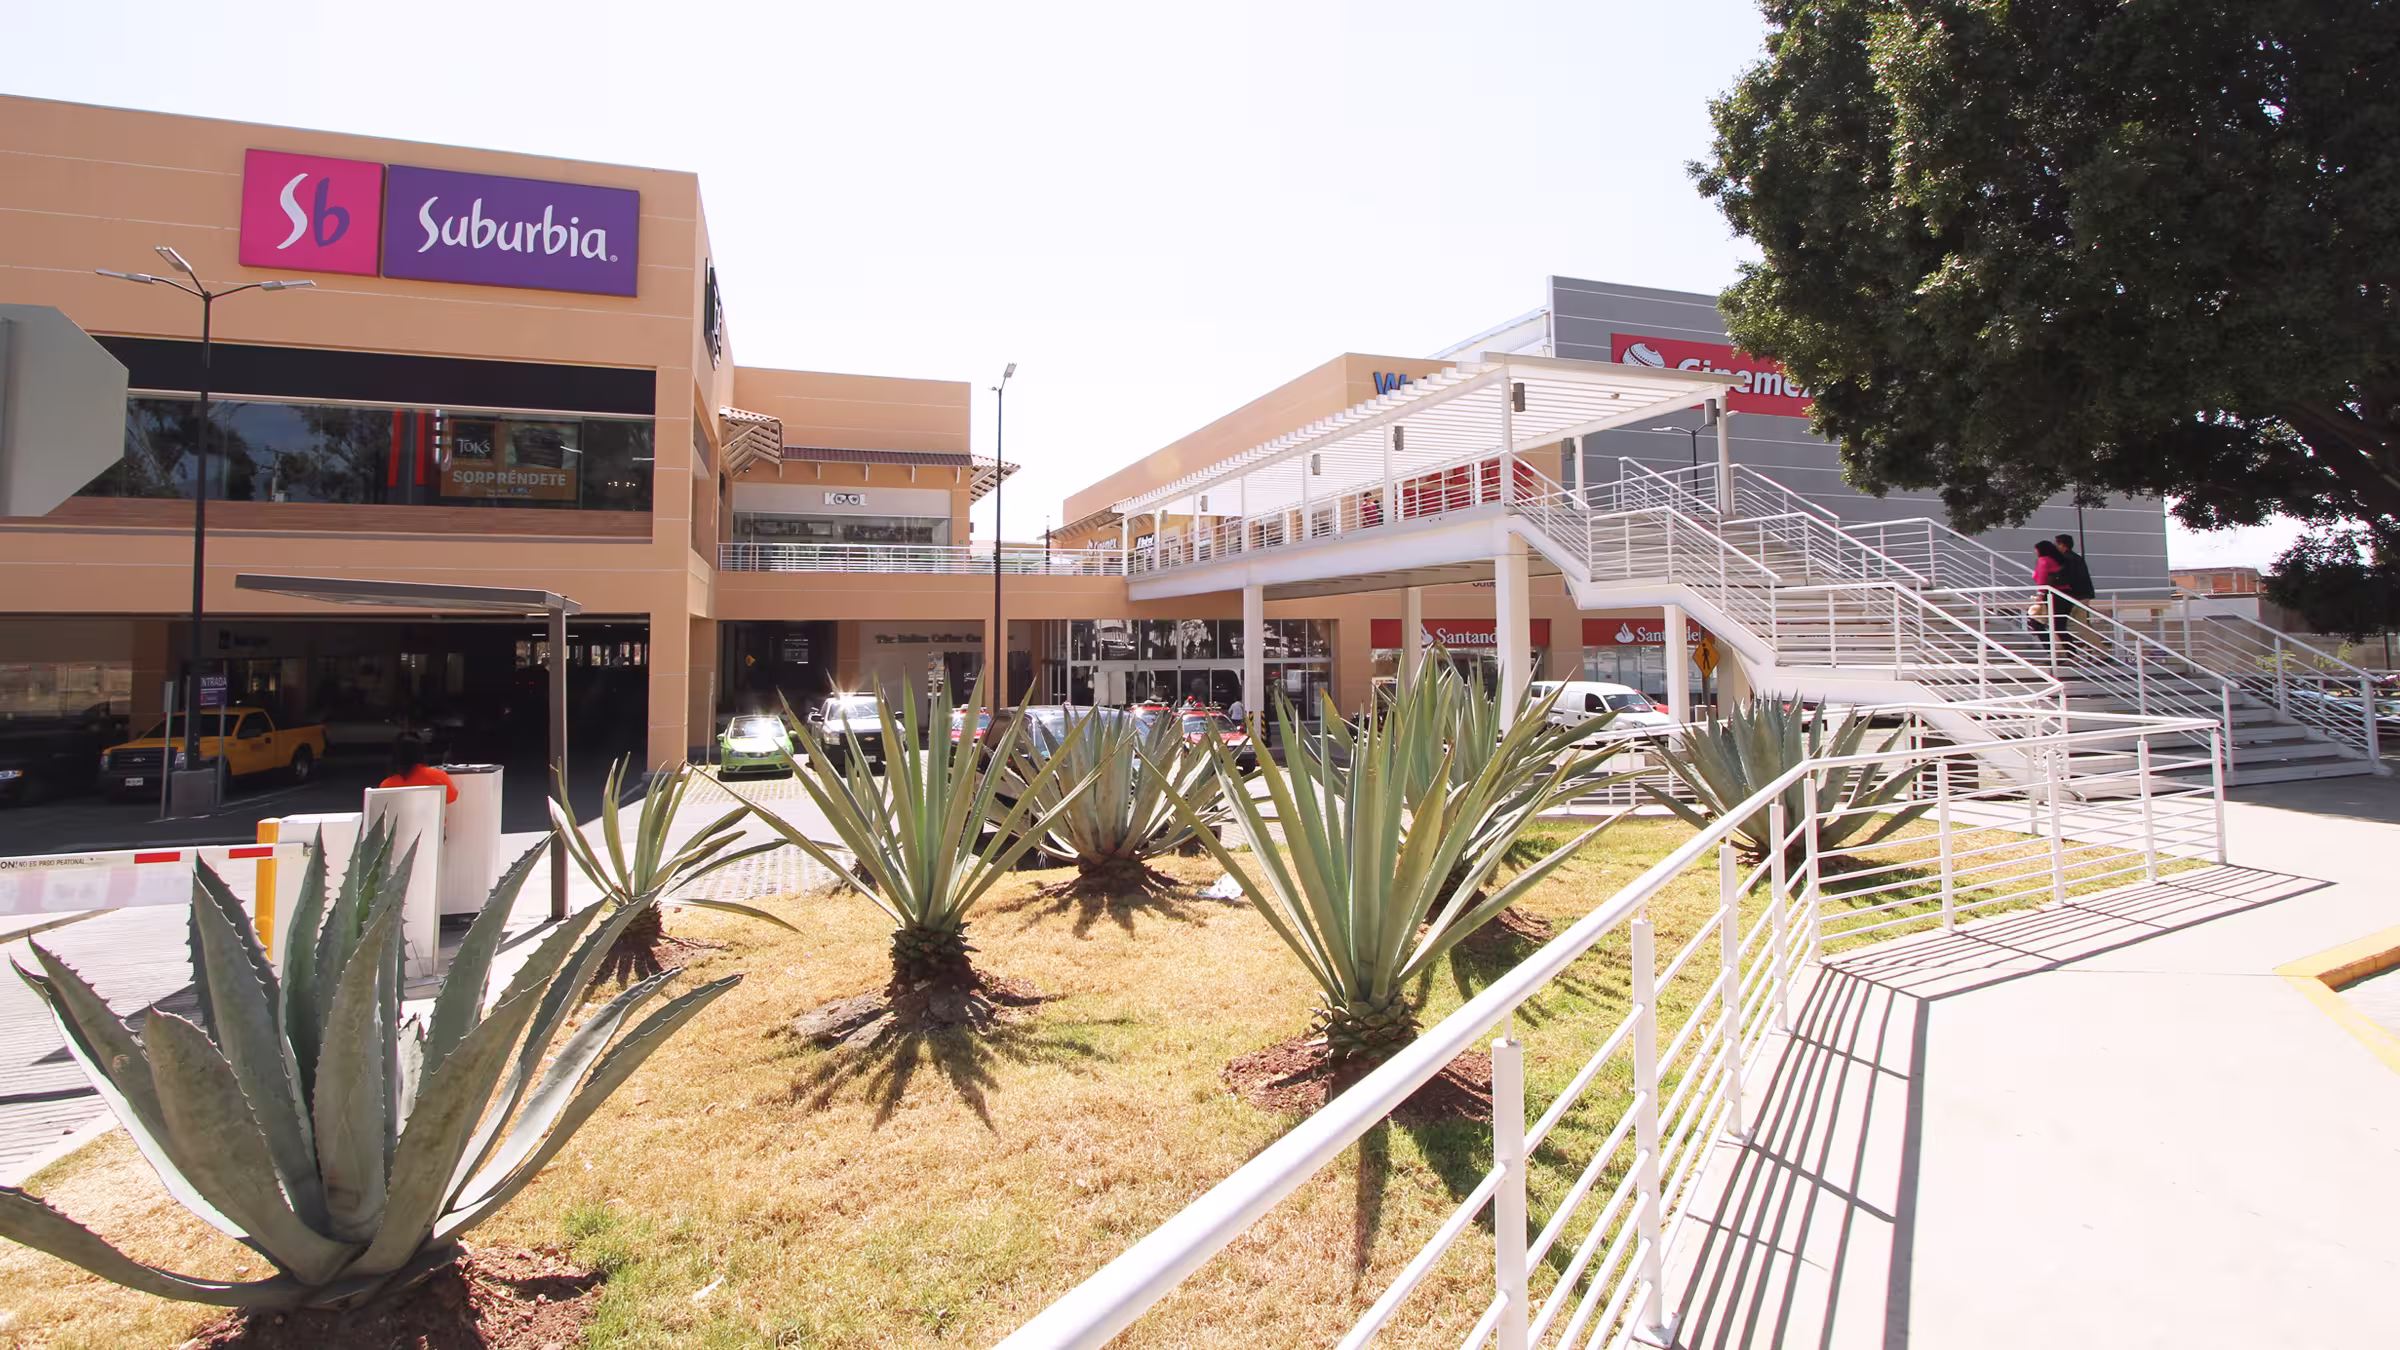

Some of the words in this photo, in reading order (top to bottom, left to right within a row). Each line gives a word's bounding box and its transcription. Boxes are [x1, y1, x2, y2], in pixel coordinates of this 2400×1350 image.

[276, 172, 350, 248] Sb
[417, 196, 607, 262] Suburbia
[1679, 358, 1811, 398] ieme
[1436, 627, 1498, 645] Santand
[1637, 626, 1703, 642] Sante
[200, 677, 226, 688] NTRADA
